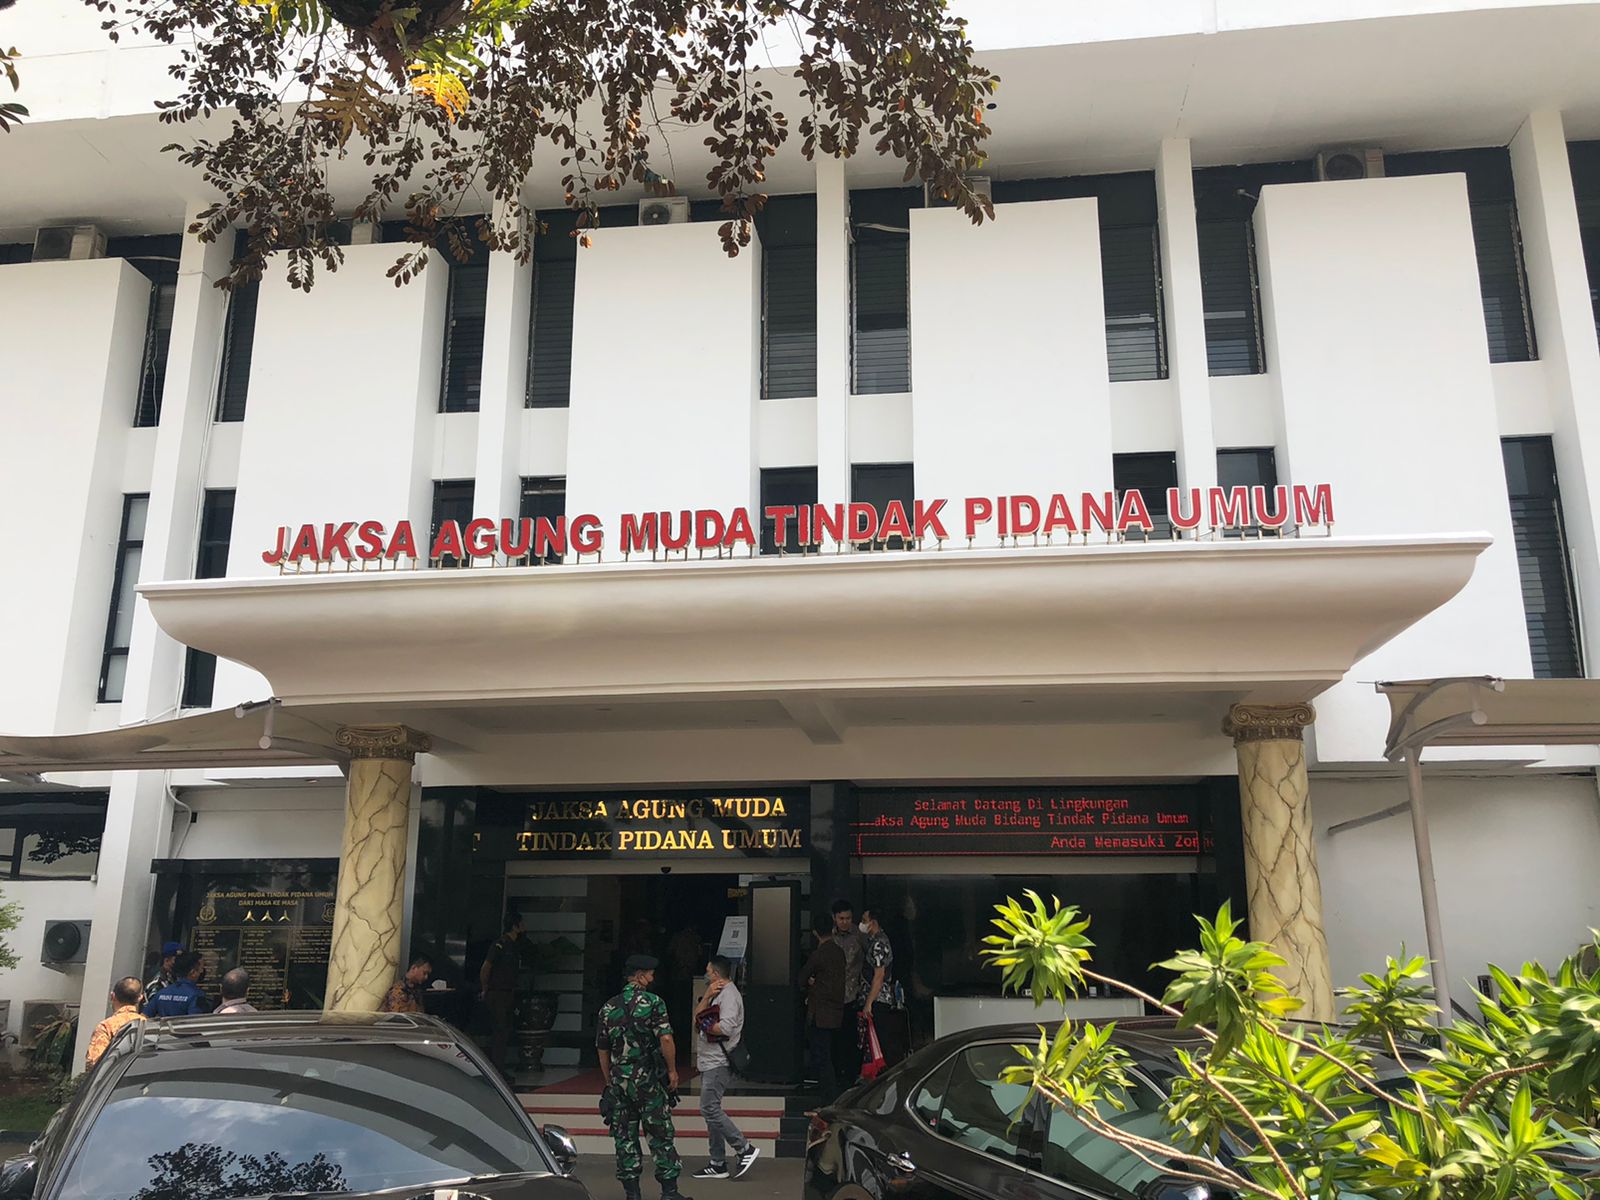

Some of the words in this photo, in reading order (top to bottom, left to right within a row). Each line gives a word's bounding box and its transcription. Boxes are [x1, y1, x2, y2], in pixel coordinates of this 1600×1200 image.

[261, 519, 418, 567] JAKSA
[429, 513, 605, 560] AGUNG
[619, 507, 757, 553] MUDA
[764, 498, 949, 546] TINDAK
[965, 489, 1154, 537] PIDANA
[1166, 483, 1336, 529] UMUM
[530, 800, 609, 821] JAKSA
[616, 799, 704, 820] AGUNG
[711, 797, 788, 818] MUDA
[914, 799, 967, 812] Selamat
[974, 799, 1022, 813] Datang
[1027, 798, 1044, 811] Di
[1050, 797, 1129, 812] Lingkungan
[910, 814, 950, 829] Agung
[955, 814, 987, 827] Muda
[994, 813, 1041, 829] Bidang
[1047, 812, 1095, 826] Tindak
[1101, 812, 1150, 825] Pidana
[1156, 812, 1189, 825] Umum
[516, 831, 612, 852] TINDAK
[618, 830, 715, 850] PIDANA
[720, 828, 802, 849] UMUM
[1050, 835, 1087, 849] Anda
[1094, 834, 1166, 849] Memasuki
